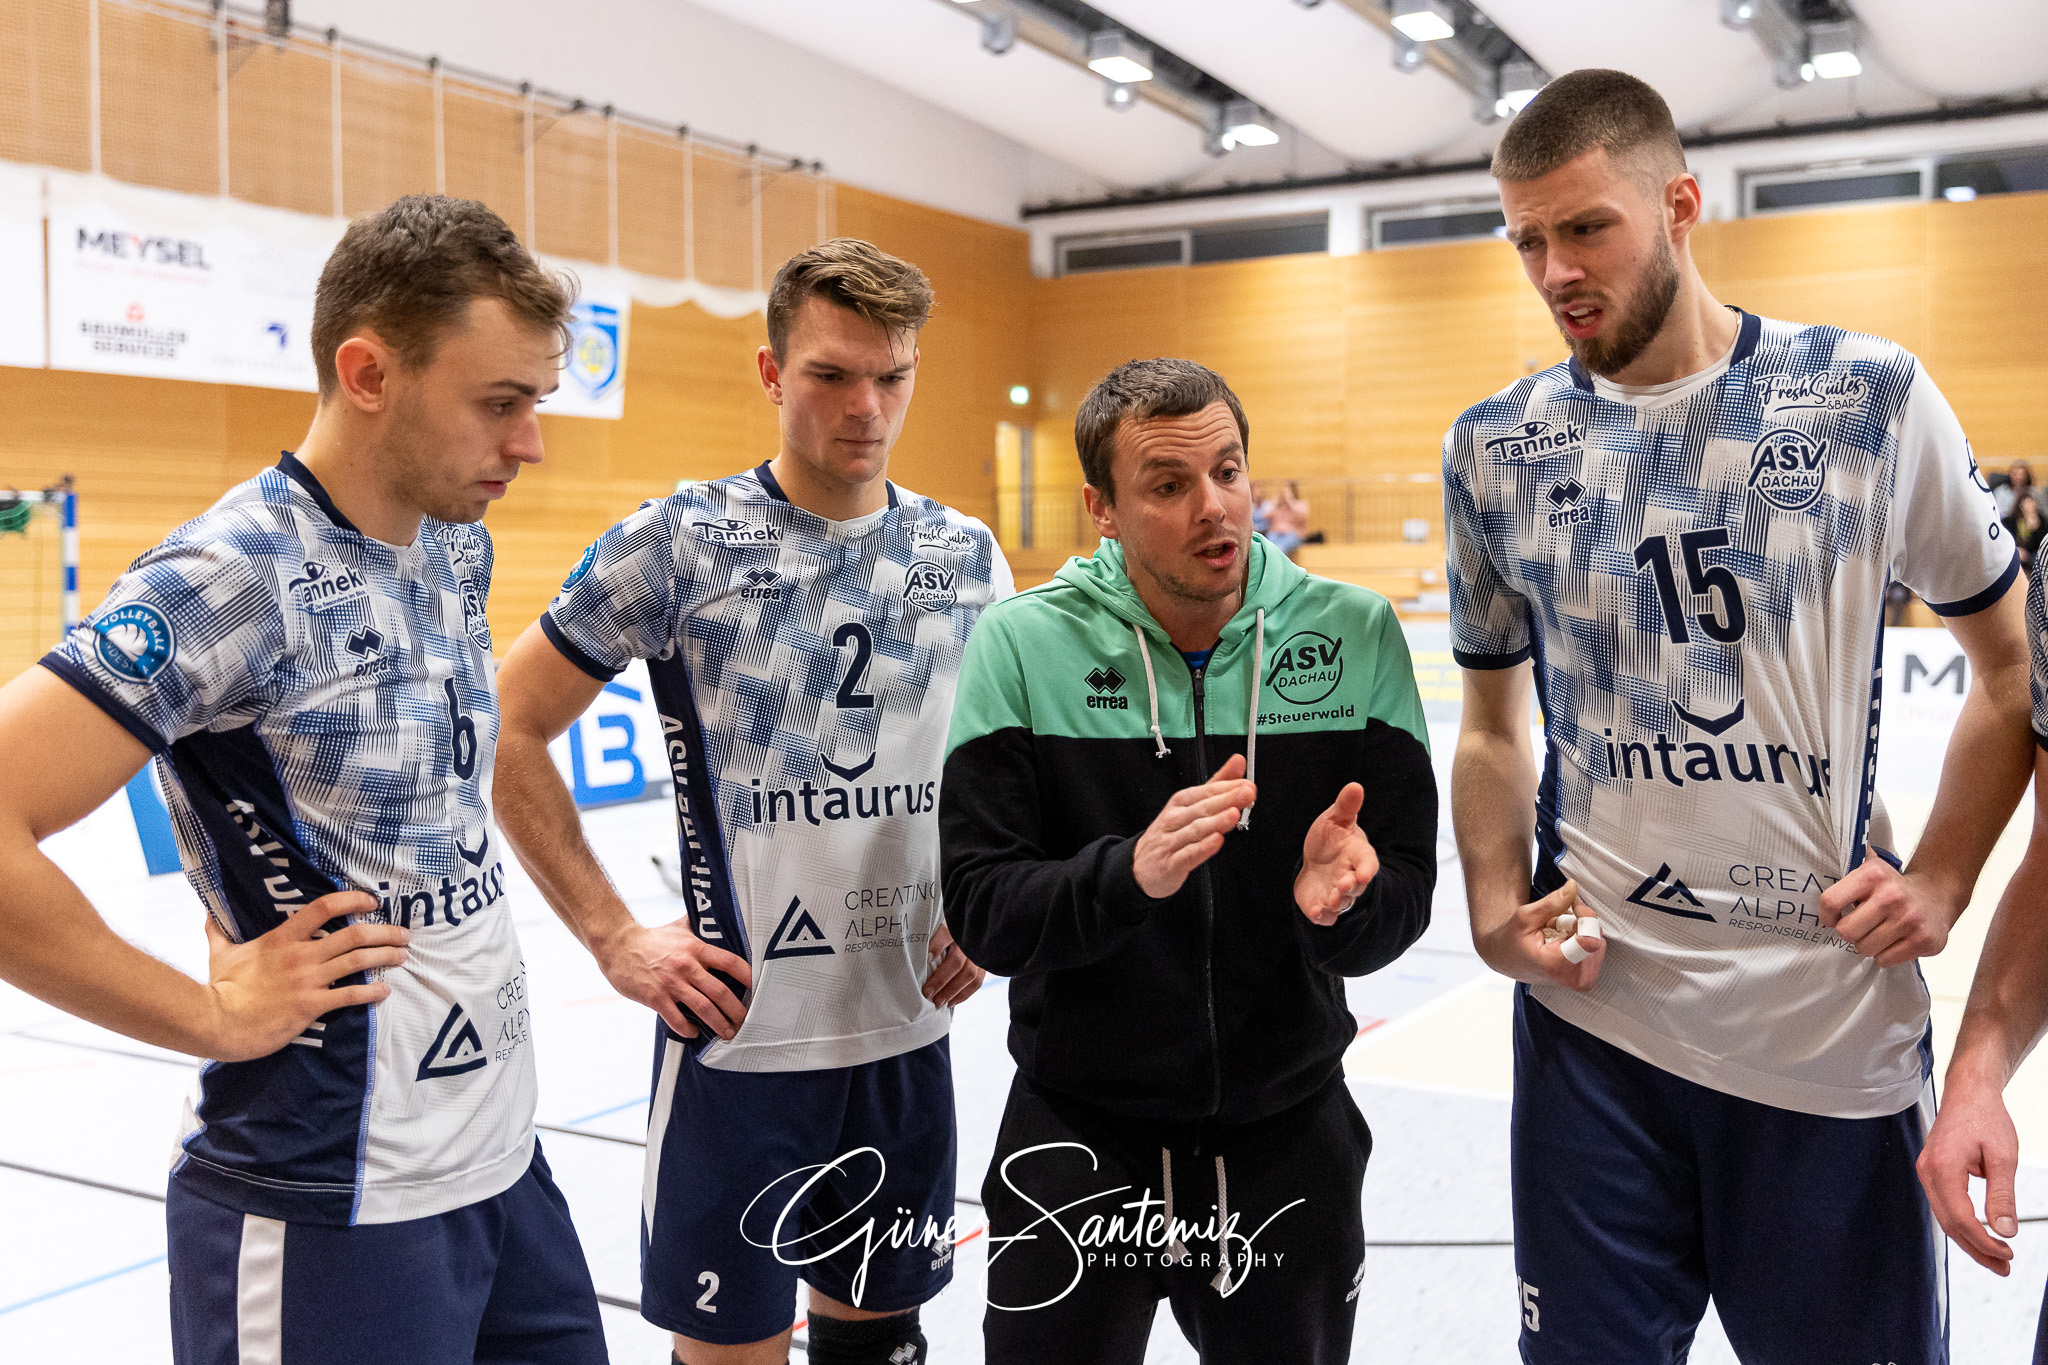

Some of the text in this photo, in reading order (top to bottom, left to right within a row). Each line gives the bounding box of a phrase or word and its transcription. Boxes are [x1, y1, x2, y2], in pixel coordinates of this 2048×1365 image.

[78, 227, 211, 270] MEYSEL
[1486, 424, 1581, 460] Tannek
[1748, 441, 1827, 487] ASV
[1761, 475, 1820, 488] DACHAU
[692, 522, 779, 541] Tannek
[1549, 506, 1590, 528] errea
[741, 587, 781, 599] errea
[903, 571, 955, 598] ASV
[912, 592, 954, 601] DACHAU
[1633, 526, 1746, 646] 15
[101, 609, 165, 652] VOLLEYBALL
[832, 622, 875, 710] 2
[1265, 637, 1343, 688] ASV
[1278, 670, 1338, 688] DACHAU
[1086, 693, 1129, 710] errea
[1257, 704, 1355, 726] #Steuerwald
[444, 677, 478, 781] 6
[752, 778, 936, 827] intaurus
[1730, 896, 1828, 929] ALPH
[1728, 918, 1822, 944] RESPONSIBLE
[695, 1270, 721, 1314] 2
